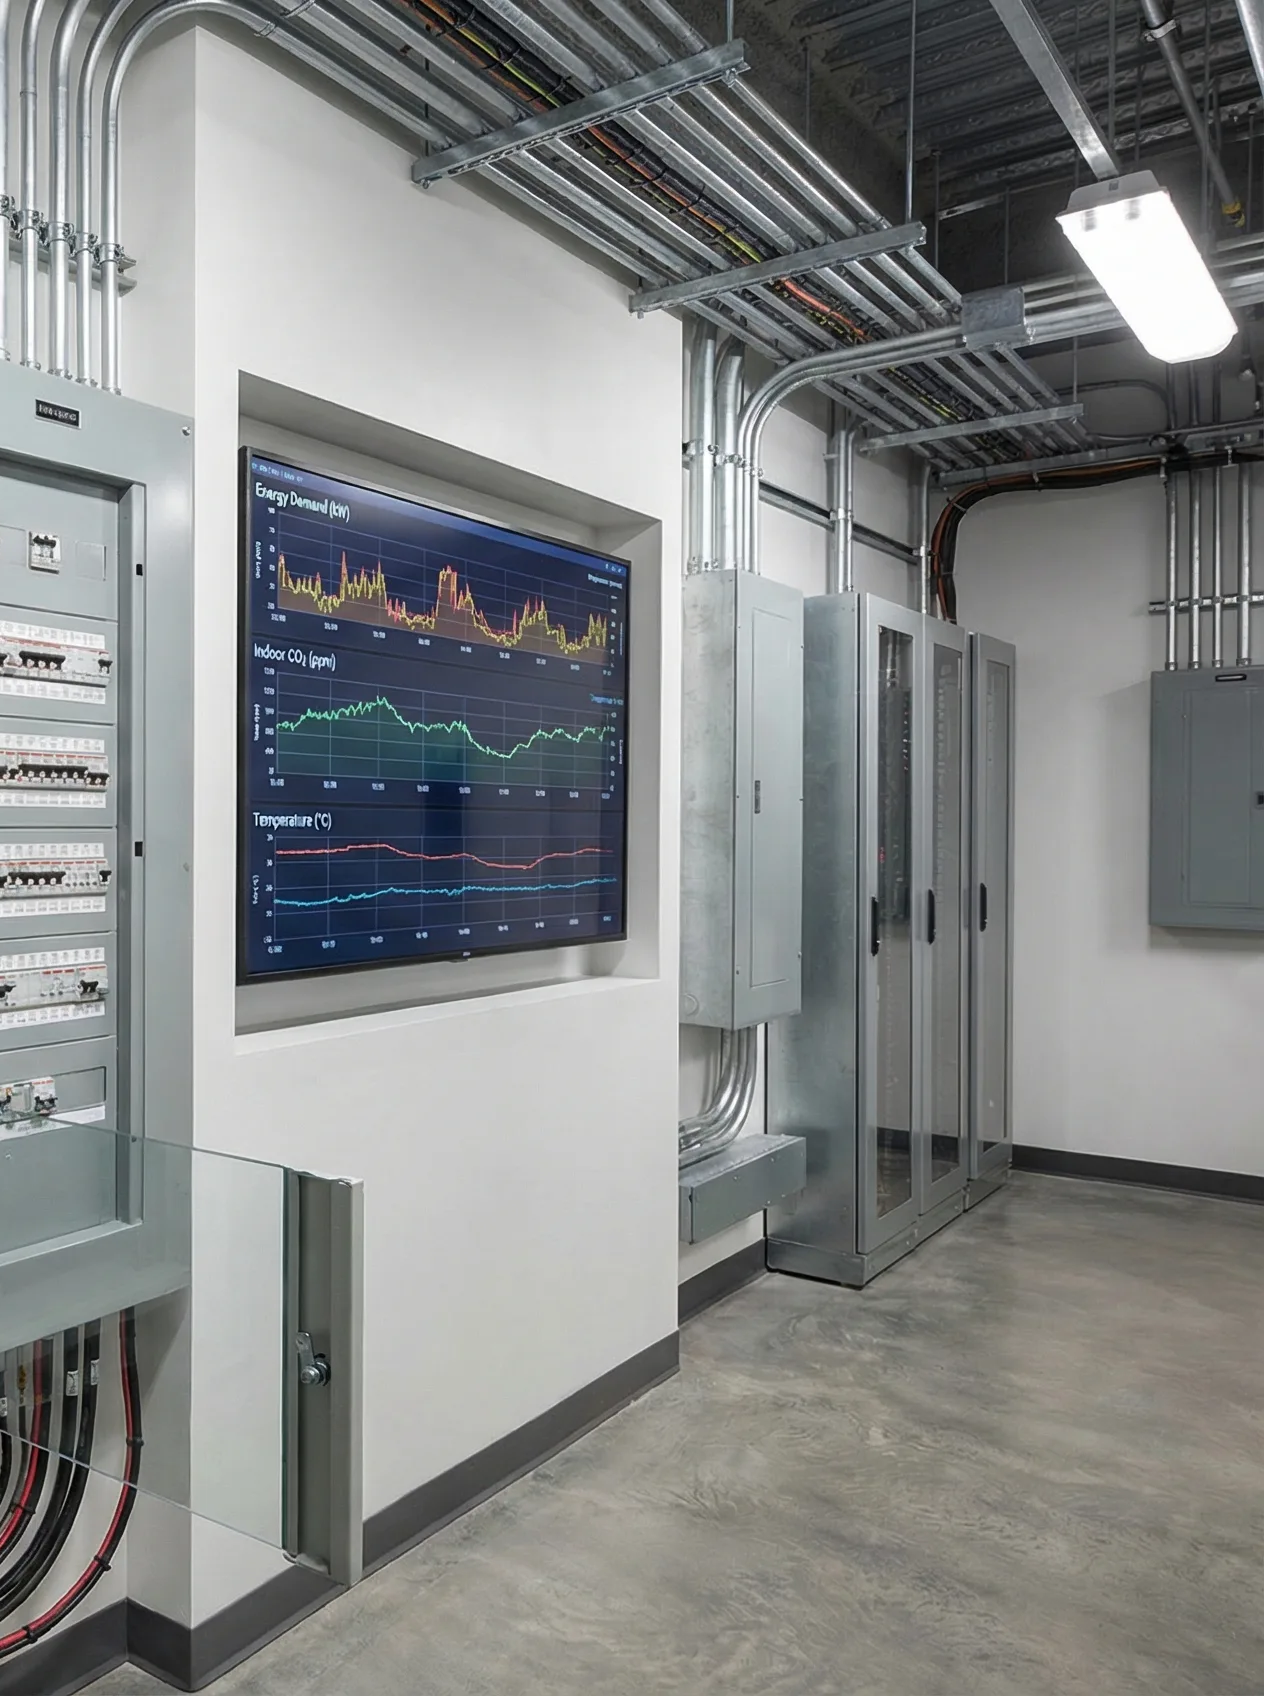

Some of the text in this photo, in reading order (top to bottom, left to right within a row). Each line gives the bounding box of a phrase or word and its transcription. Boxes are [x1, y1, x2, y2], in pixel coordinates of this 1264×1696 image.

[255, 482, 350, 523] Energy Demand (kW)
[254, 643, 285, 661] Indoor
[253, 812, 313, 830] Temperature
